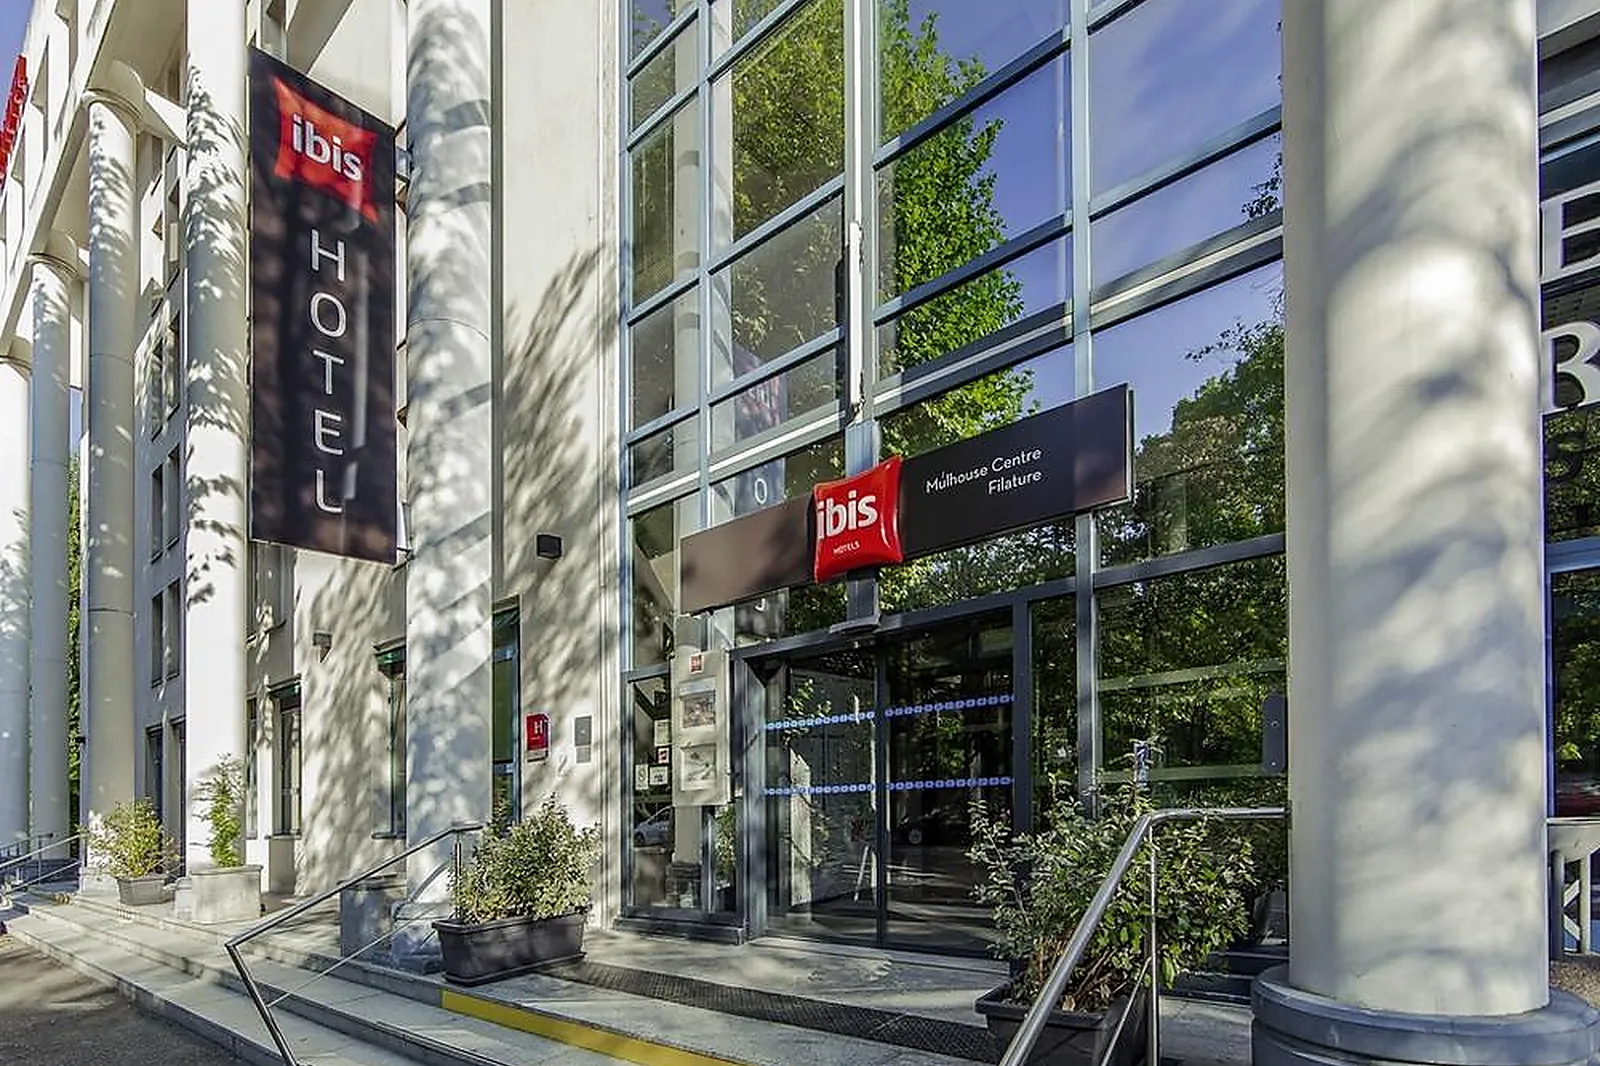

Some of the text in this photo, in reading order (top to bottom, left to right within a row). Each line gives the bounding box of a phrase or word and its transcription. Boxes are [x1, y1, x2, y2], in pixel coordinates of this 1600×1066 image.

[293, 113, 362, 181] ibis
[310, 229, 347, 513] HOTEL
[988, 471, 1042, 494] Filature
[991, 449, 1042, 472] Centre
[817, 490, 878, 539] ibis
